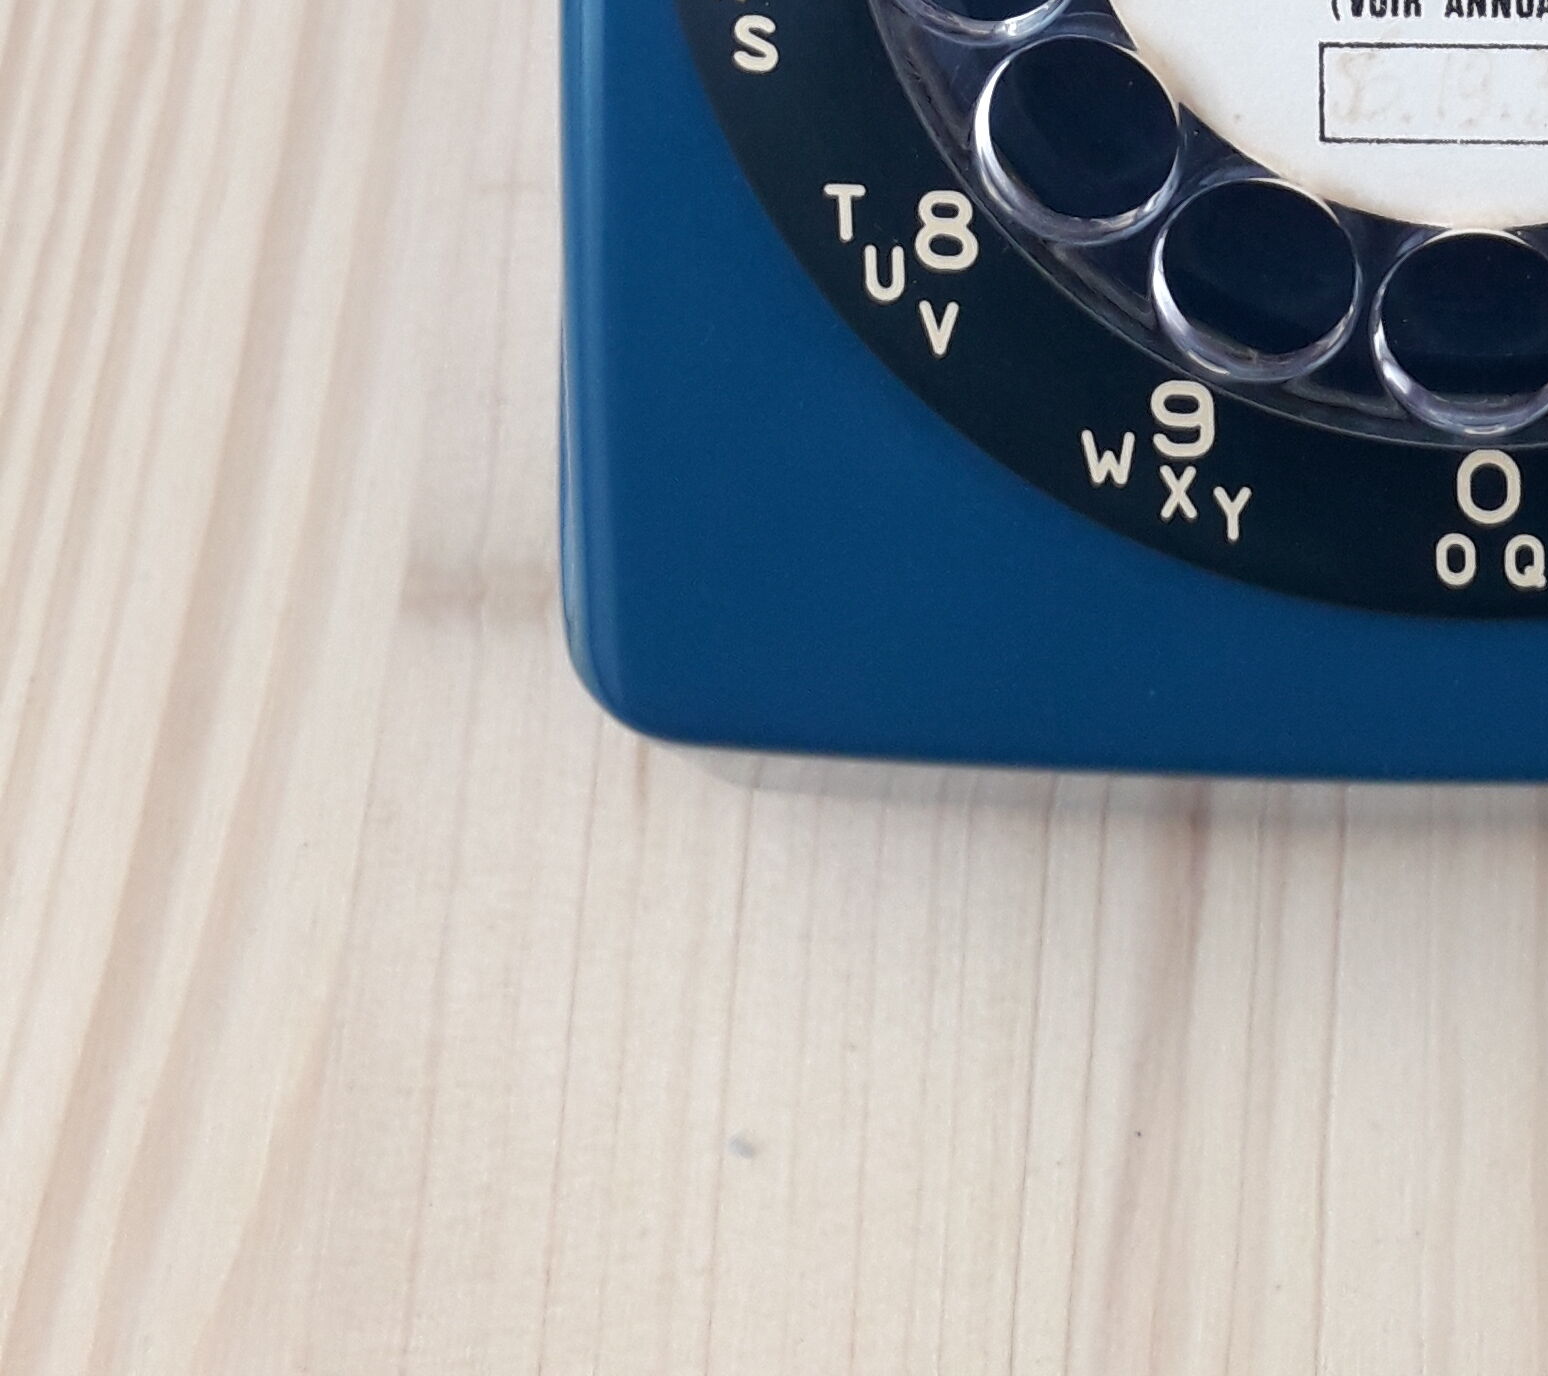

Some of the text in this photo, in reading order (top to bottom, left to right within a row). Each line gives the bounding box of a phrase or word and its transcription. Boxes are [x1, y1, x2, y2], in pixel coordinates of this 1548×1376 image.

[913, 189, 980, 272] 8
[1149, 379, 1216, 459] 9
[1455, 448, 1522, 526] 0
